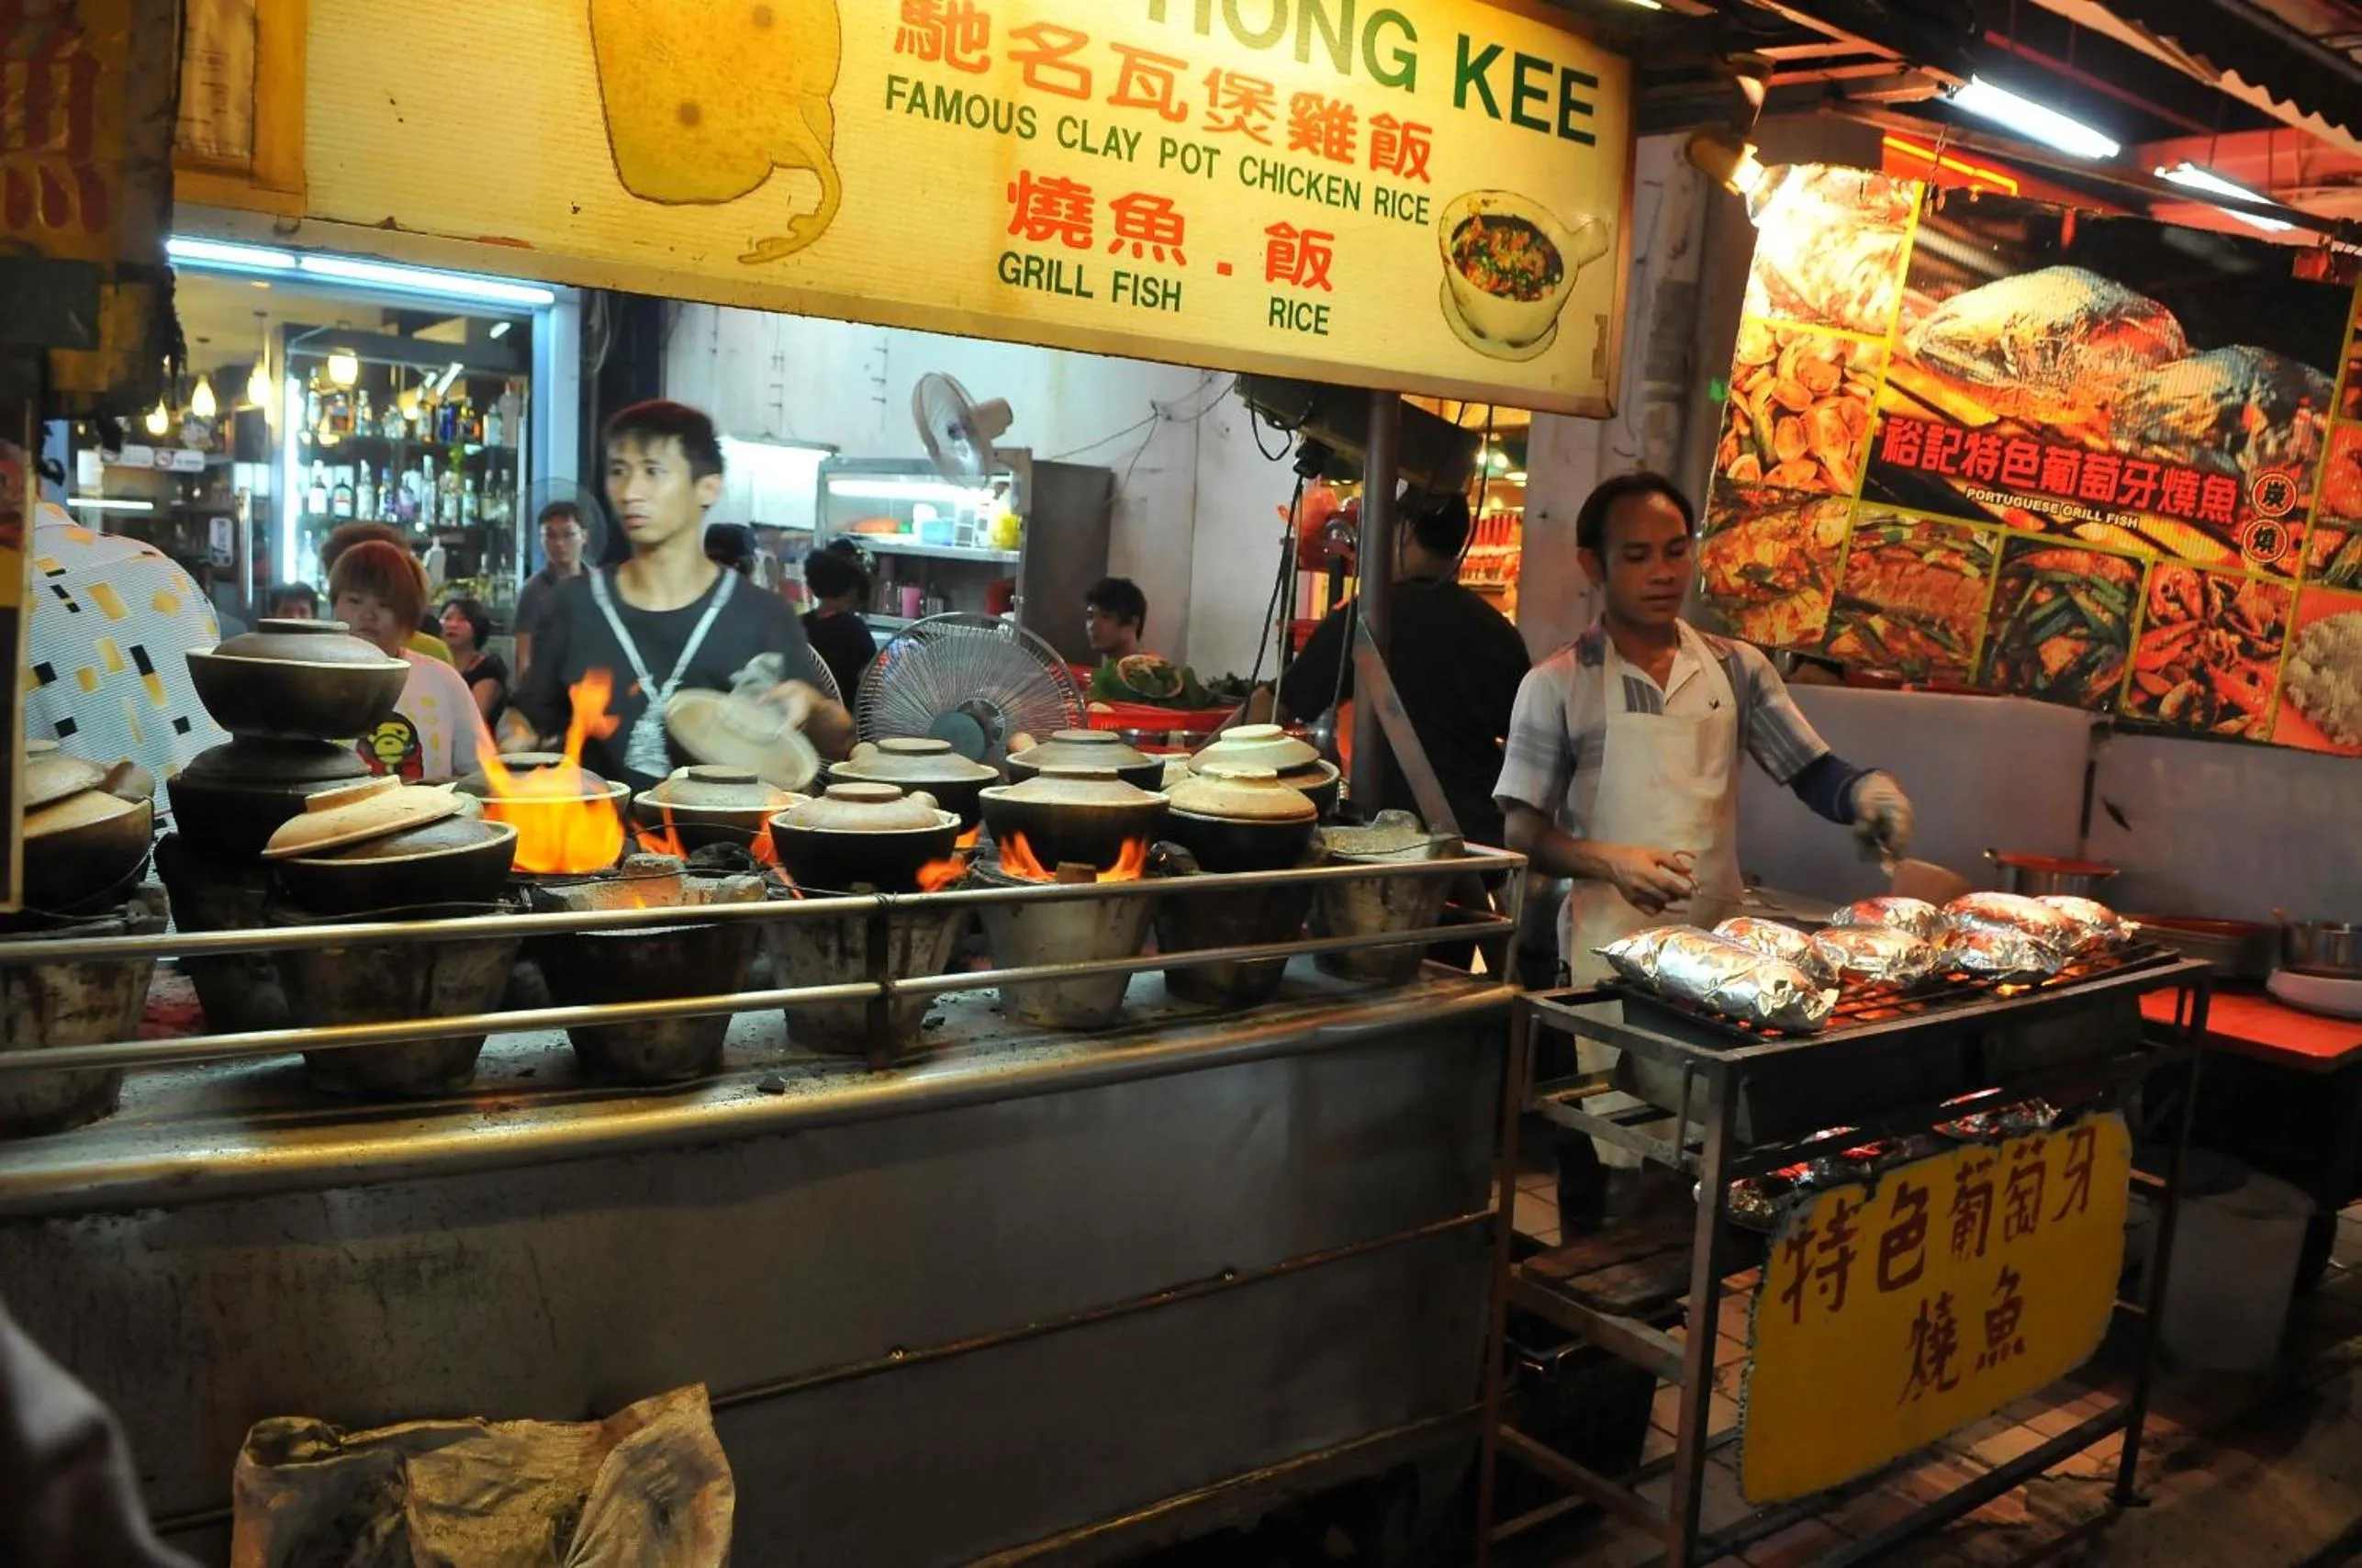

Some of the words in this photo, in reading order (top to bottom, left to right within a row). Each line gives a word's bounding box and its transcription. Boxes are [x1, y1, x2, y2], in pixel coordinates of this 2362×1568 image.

[885, 73, 1037, 140] FAMOUS
[1057, 115, 1142, 162] CLAY
[1159, 136, 1221, 179] POT
[1238, 155, 1361, 211] CHICKEN
[1373, 186, 1430, 226] RICE
[893, 0, 1433, 184] 馳名瓦煲雞飯
[1453, 33, 1599, 148] KEE
[997, 251, 1093, 299] GRILL
[1111, 270, 1182, 312] FISH
[1268, 296, 1331, 336] RICE
[1965, 487, 2060, 515] PORTUGUESE
[2062, 504, 2102, 522] GRILL
[2106, 512, 2140, 530] FISH
[1780, 1126, 2096, 1326] 特色葡萄牙
[1896, 1265, 2027, 1408] 燒魚
